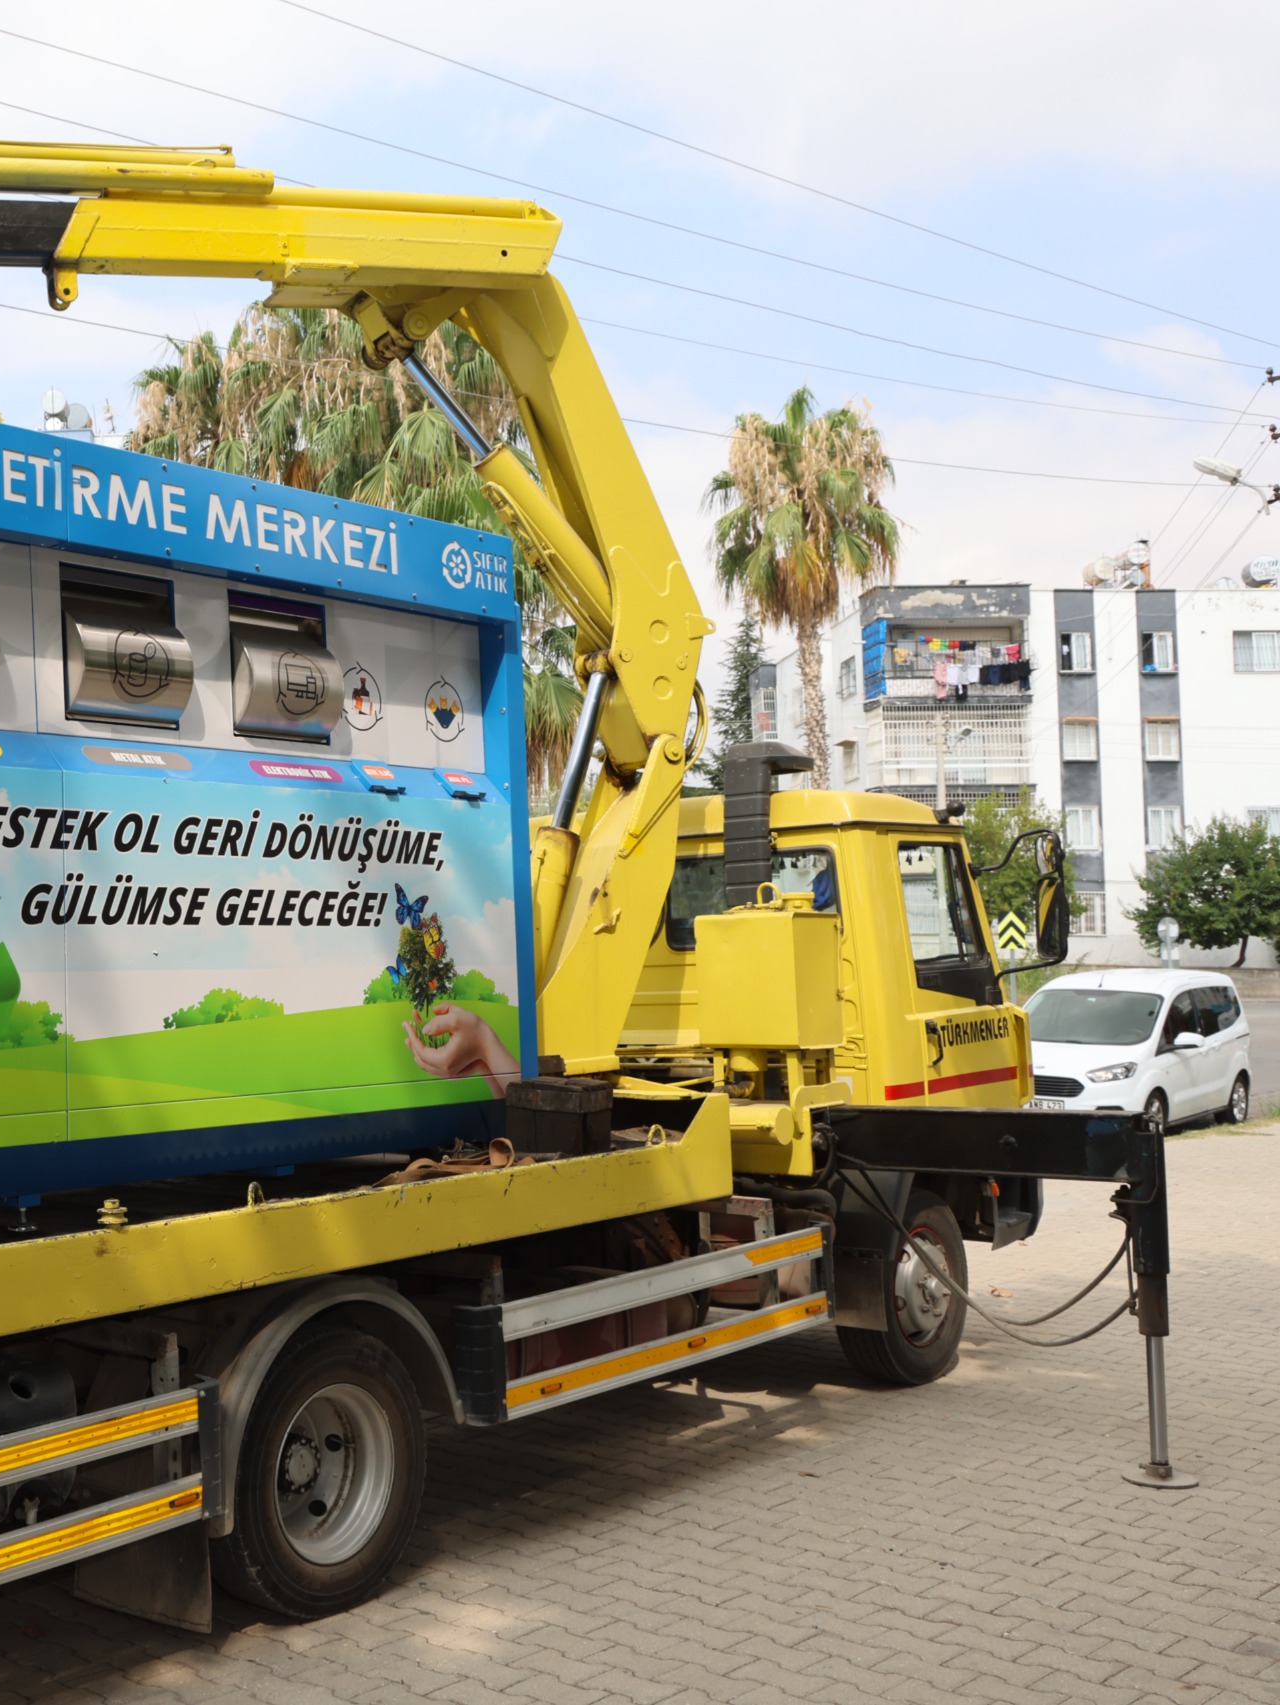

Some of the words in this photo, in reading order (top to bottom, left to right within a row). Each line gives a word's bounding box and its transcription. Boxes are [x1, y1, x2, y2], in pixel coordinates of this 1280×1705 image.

[206, 494, 399, 575] MERKEZİ
[473, 550, 507, 574] SIFIR
[475, 570, 508, 594] ATIK
[110, 751, 144, 764] METAL
[113, 812, 160, 853] OL
[173, 810, 261, 857] GERİ
[262, 813, 445, 873] DÖNÜŞÜME,
[20, 872, 210, 926] GÜLÜMSE
[216, 880, 389, 928] GELECEĞE!
[940, 1016, 1010, 1048] TÜRKMENLER
